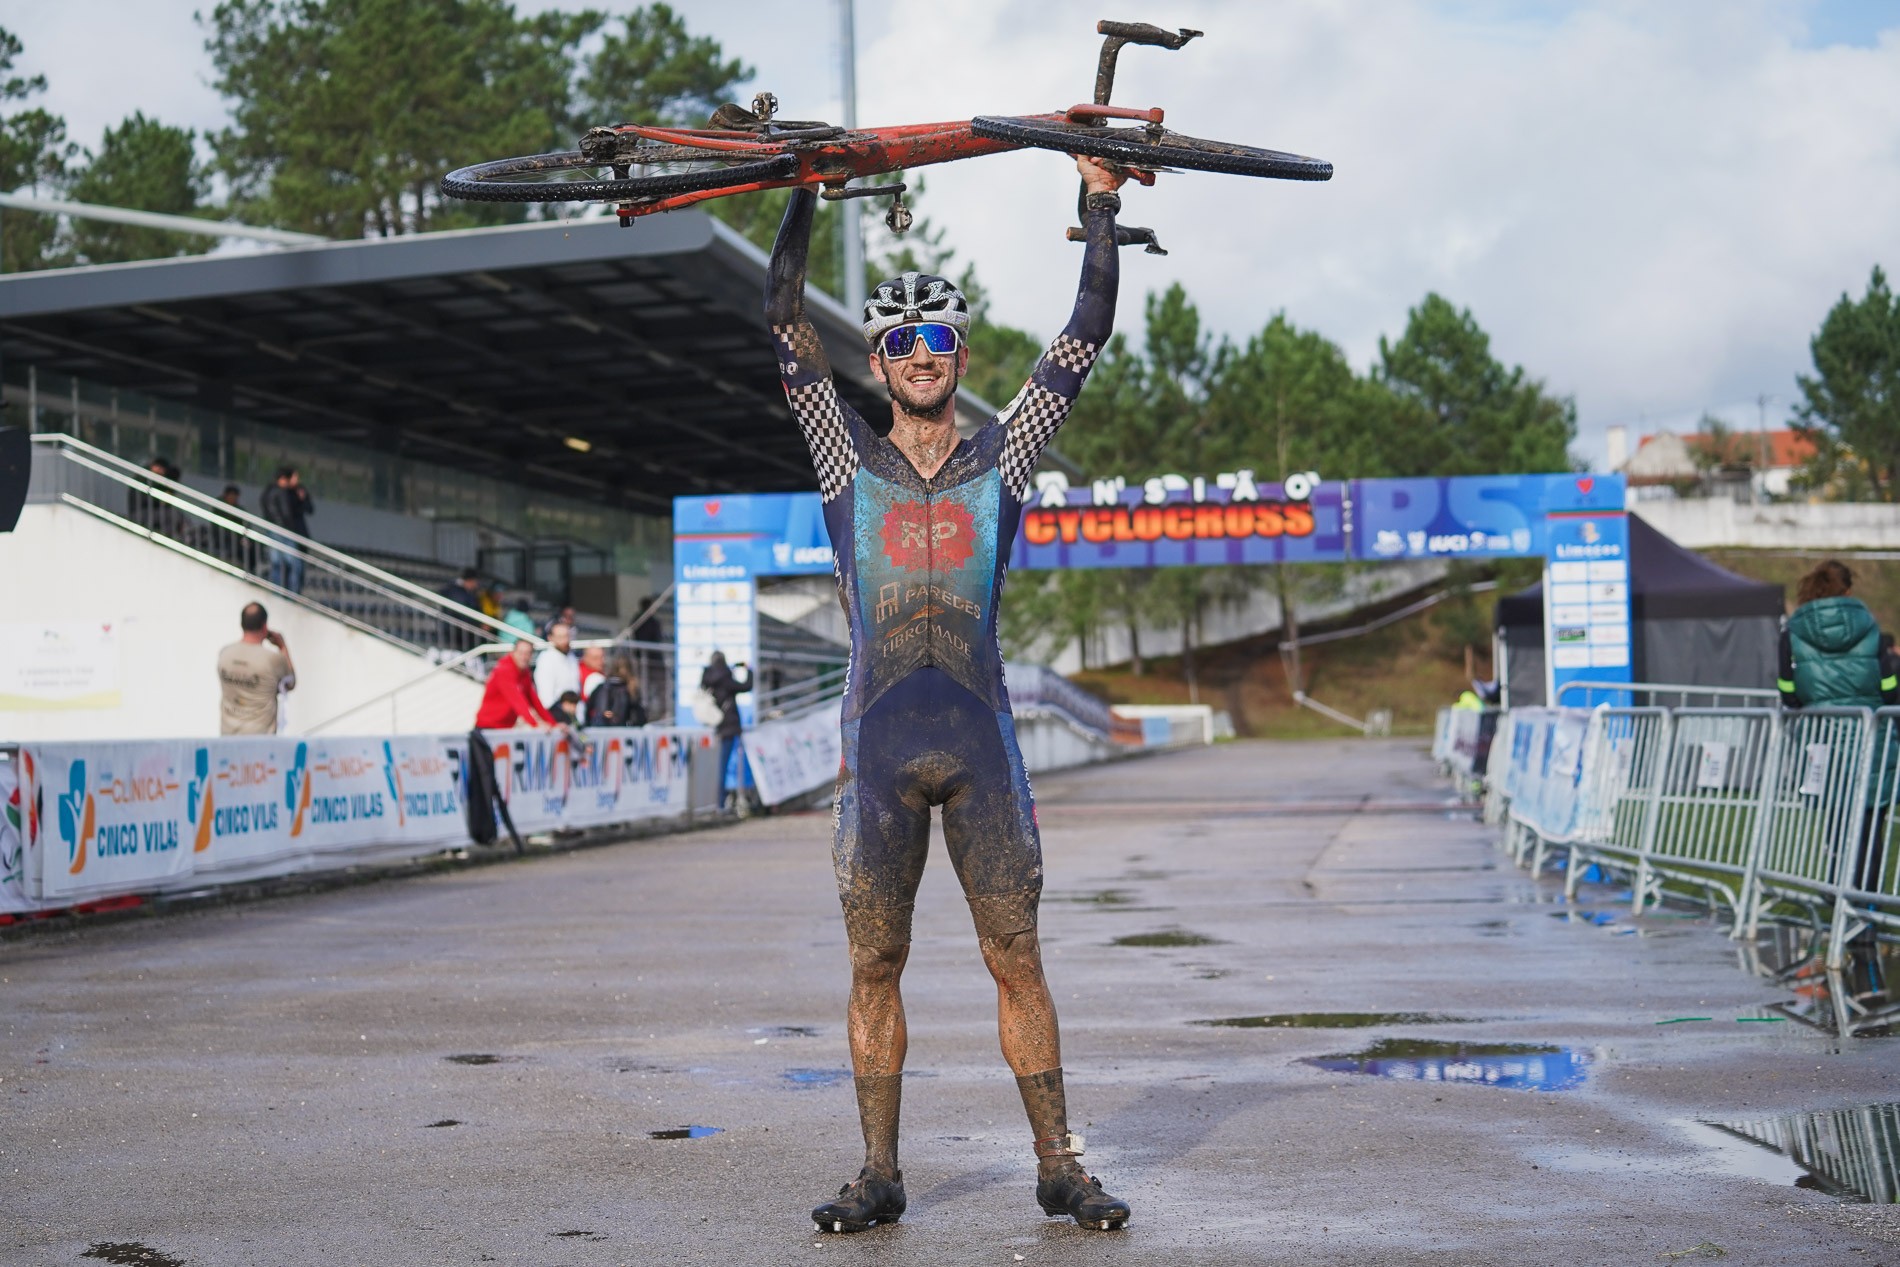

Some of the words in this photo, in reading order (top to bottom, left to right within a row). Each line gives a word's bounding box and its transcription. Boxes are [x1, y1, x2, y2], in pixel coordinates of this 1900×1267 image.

[901, 520, 958, 549] RP
[1024, 500, 1314, 545] CYCLOCROSS
[905, 584, 981, 620] PAREDES
[215, 805, 249, 837] CINCO
[251, 801, 278, 832] VILAS
[311, 795, 347, 824] CINCO
[350, 790, 383, 820] VILAS
[97, 822, 138, 858] CINCO
[142, 818, 178, 854] VILAS
